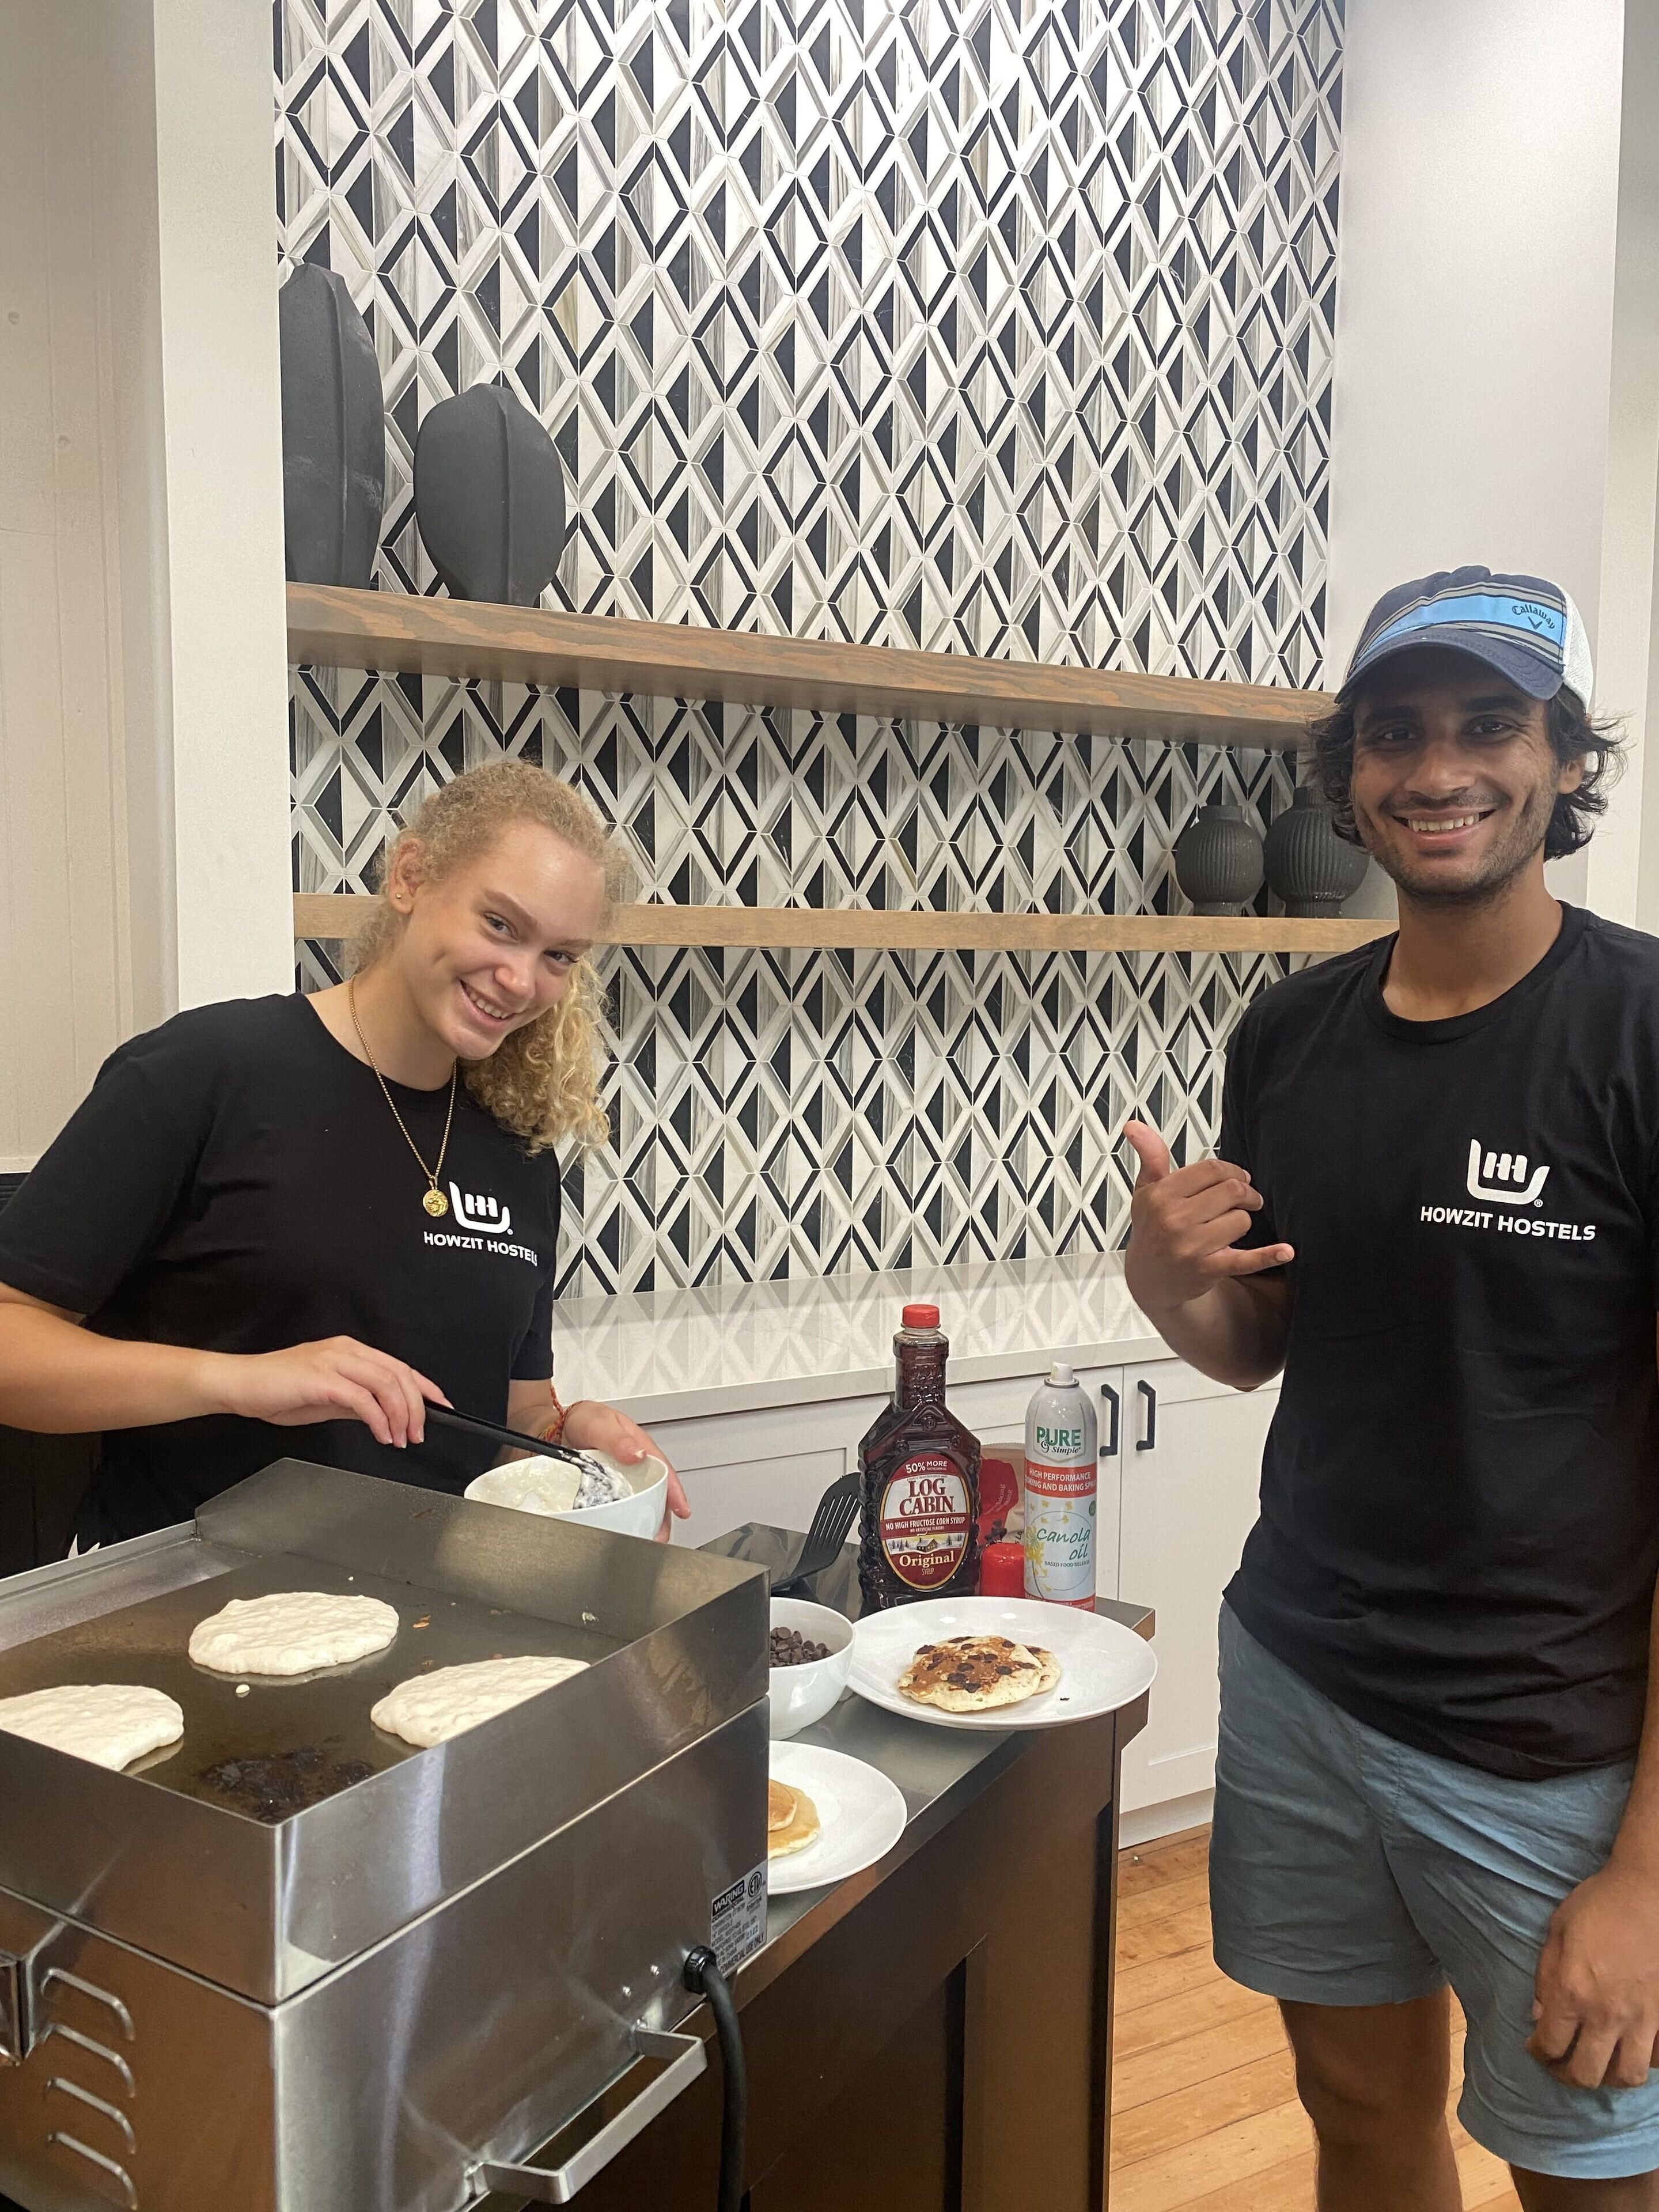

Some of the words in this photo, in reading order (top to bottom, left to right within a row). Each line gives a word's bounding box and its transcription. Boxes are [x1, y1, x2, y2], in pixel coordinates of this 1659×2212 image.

[1512, 604, 1555, 629] Callaway
[1420, 1206, 1494, 1229] HOWZIT
[1497, 1214, 1596, 1241] HOSTELS
[423, 1231, 484, 1250] HOWZIT
[1037, 1426, 1081, 1446] PURE
[1052, 1446, 1080, 1455] Simple
[906, 1461, 926, 1474] 50%
[1029, 1468, 1042, 1479] HIGH
[1043, 1471, 1091, 1482] PERFORMANCE
[908, 1478, 946, 1498] LOG
[1042, 1482, 1057, 1491] AND
[1058, 1483, 1084, 1492] BAKING
[899, 1496, 955, 1516] CABIN
[885, 1522, 893, 1531] NO
[895, 1521, 908, 1529] HIGH
[910, 1518, 935, 1528] FRUCTOSE
[899, 1551, 955, 1568] Original
[1069, 1543, 1088, 1560] oil
[922, 1567, 934, 1575] SYRUP
[714, 1883, 743, 1912] WARING
